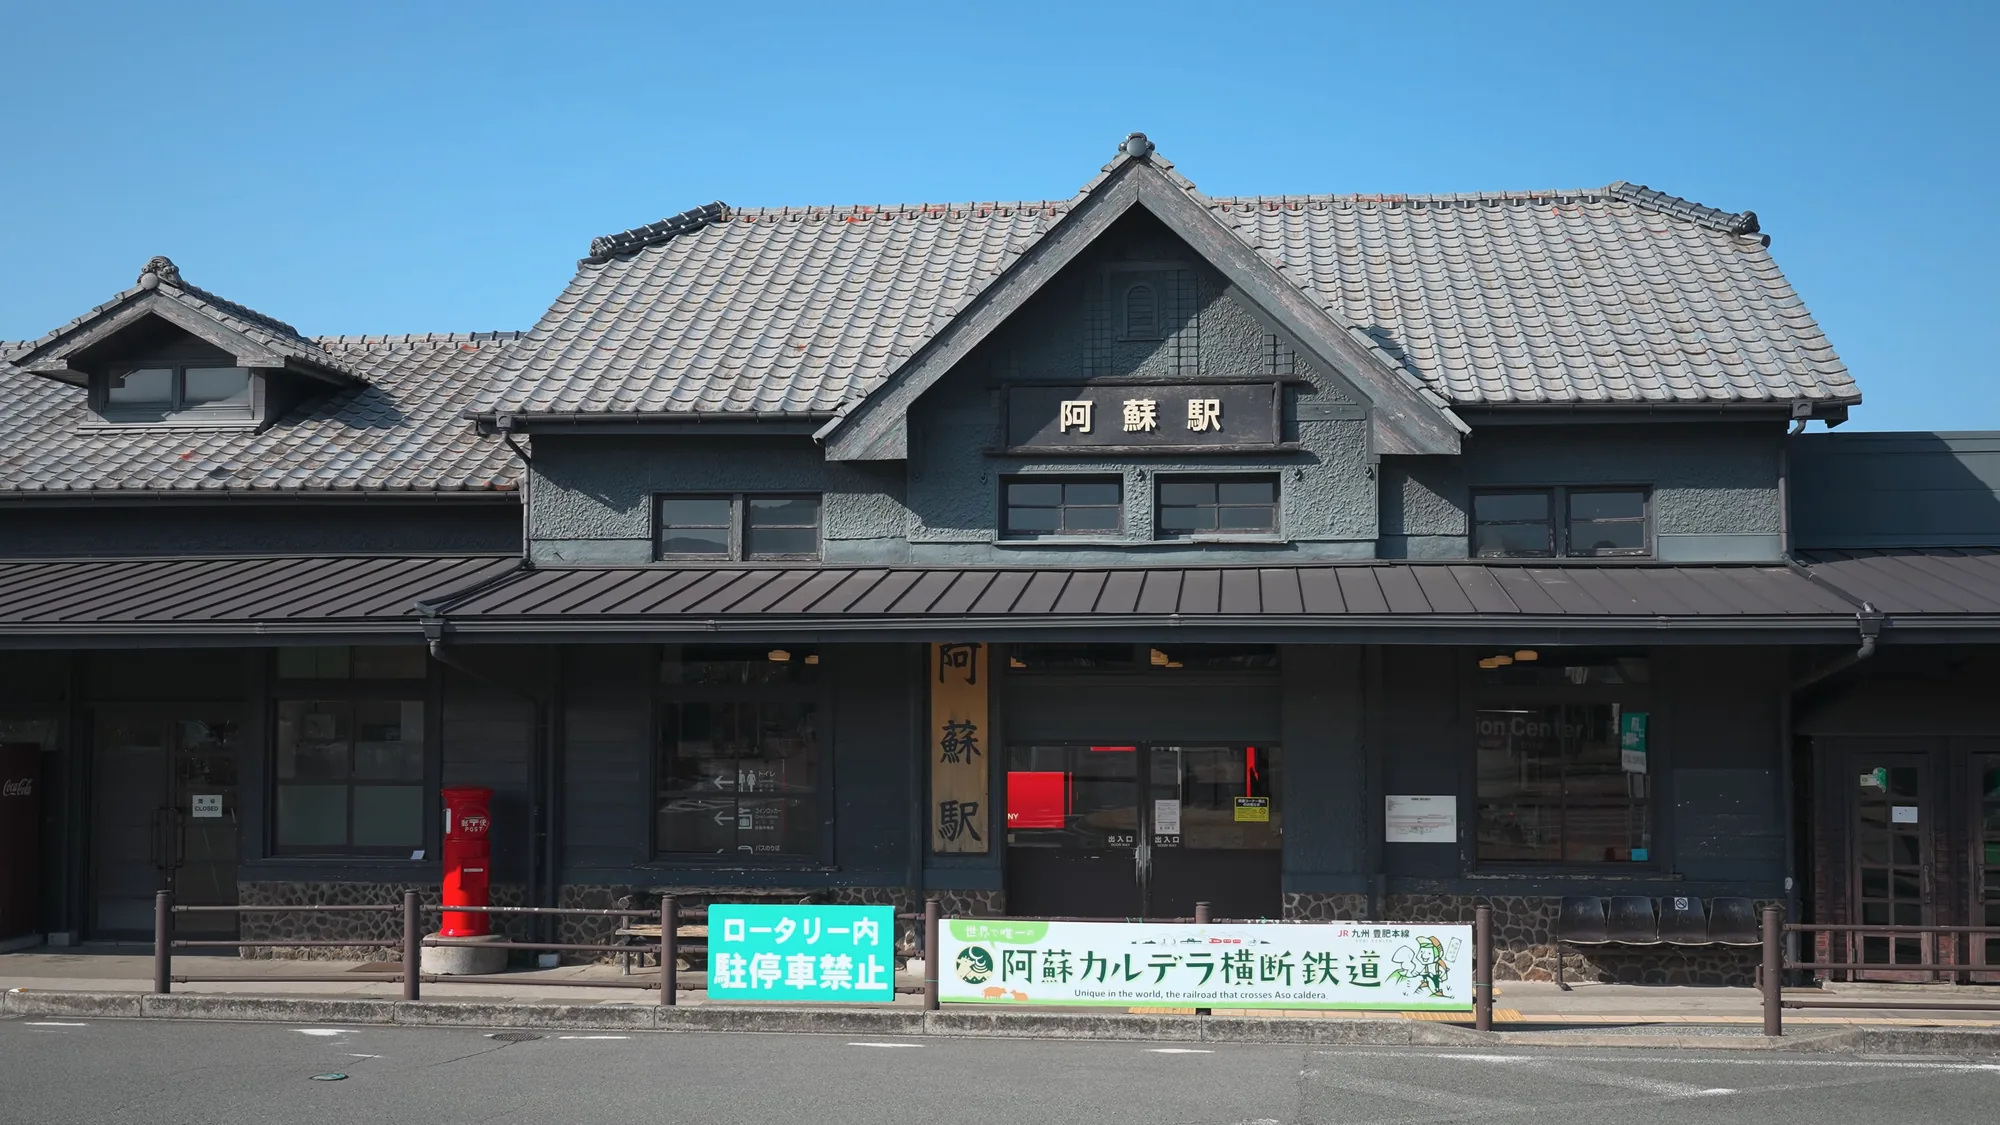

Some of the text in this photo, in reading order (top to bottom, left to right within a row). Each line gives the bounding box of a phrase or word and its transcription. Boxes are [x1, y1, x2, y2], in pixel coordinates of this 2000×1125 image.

[1060, 399, 1221, 433] 阿蘇駅
[939, 642, 982, 842] 阿蘇駅
[1107, 835, 1133, 843] 出入口
[1154, 836, 1180, 844] 出入口
[723, 916, 879, 946] ロータリー内
[965, 925, 1034, 940] 世界で唯一の
[1337, 929, 1349, 938] JR
[713, 952, 888, 991] 駐停車禁止
[1002, 949, 1381, 987] 阿蘇カルデラ横断鉄道
[1074, 989, 1105, 999] Unique
[1107, 989, 1116, 998] in
[1118, 990, 1133, 998] the
[1135, 990, 1164, 999] world,
[1166, 990, 1180, 998] the
[1182, 990, 1217, 999] railroad
[1219, 990, 1239, 999] that
[1240, 991, 1272, 999] crosses
[1274, 990, 1291, 999] Aso
